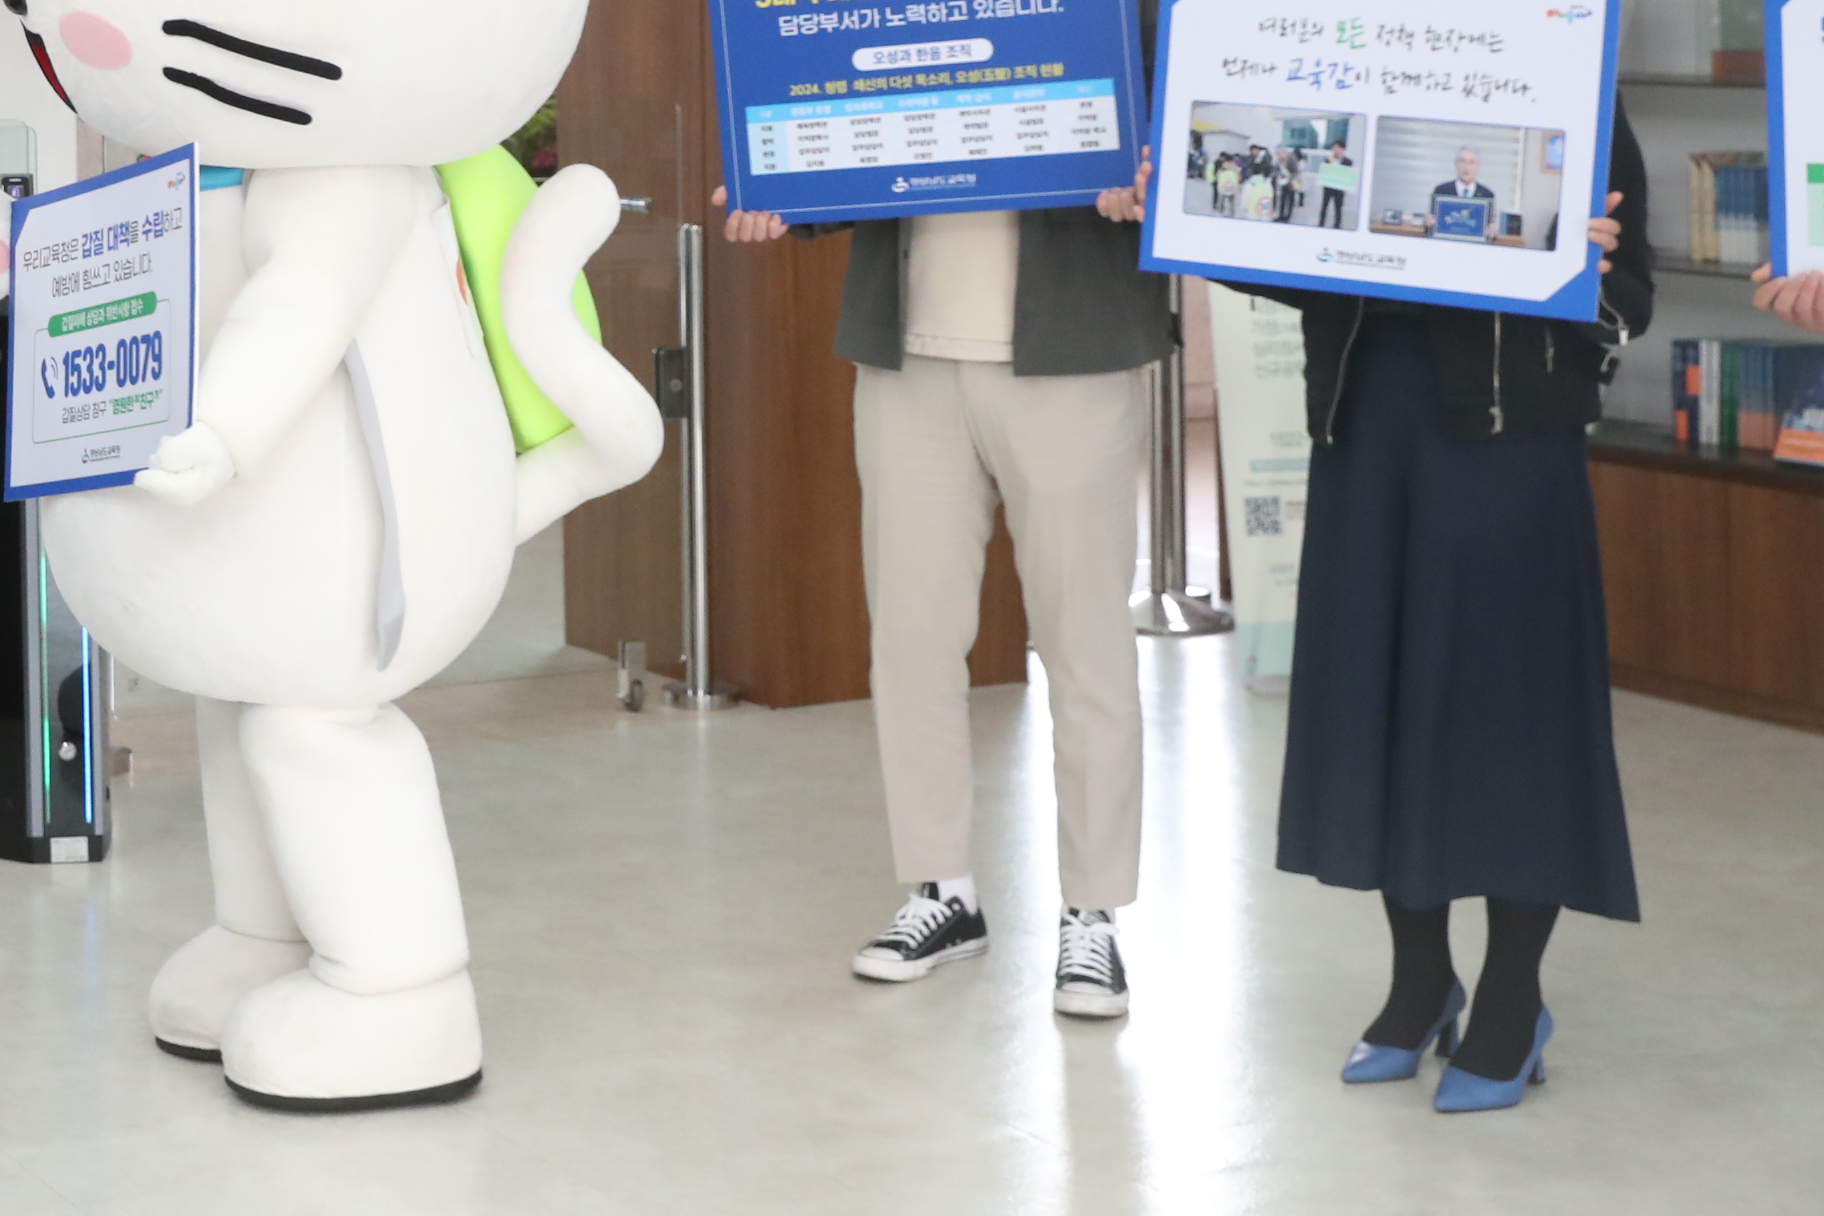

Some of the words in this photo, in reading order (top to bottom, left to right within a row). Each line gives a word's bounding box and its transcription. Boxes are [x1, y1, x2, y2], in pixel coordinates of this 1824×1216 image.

[778, 6, 881, 37] 담당부서가
[885, 0, 969, 27] 노력하고
[1258, 17, 1324, 43] 여러분의
[1336, 17, 1366, 49] 모든
[1376, 24, 1416, 50] 정책
[1425, 25, 1503, 52] 현장에는
[873, 48, 912, 65] 오성과
[947, 44, 972, 60] 조직
[1222, 56, 1278, 77] 언제나
[1286, 57, 1370, 91] 교육감이
[1380, 65, 1454, 95] 함께하고
[1461, 72, 1536, 103] 있습니다.
[23, 238, 79, 273] 우리교육청은
[82, 228, 104, 259] 갑질
[107, 220, 139, 252] 대책을
[141, 207, 183, 242] 수립하고
[51, 272, 80, 298] 예방에
[83, 264, 111, 291] 힘쓰고
[113, 252, 154, 283] 있습니다.
[63, 330, 163, 398] 1533-0079
[62, 404, 91, 424] 갑질상담
[93, 401, 107, 419] 창구
